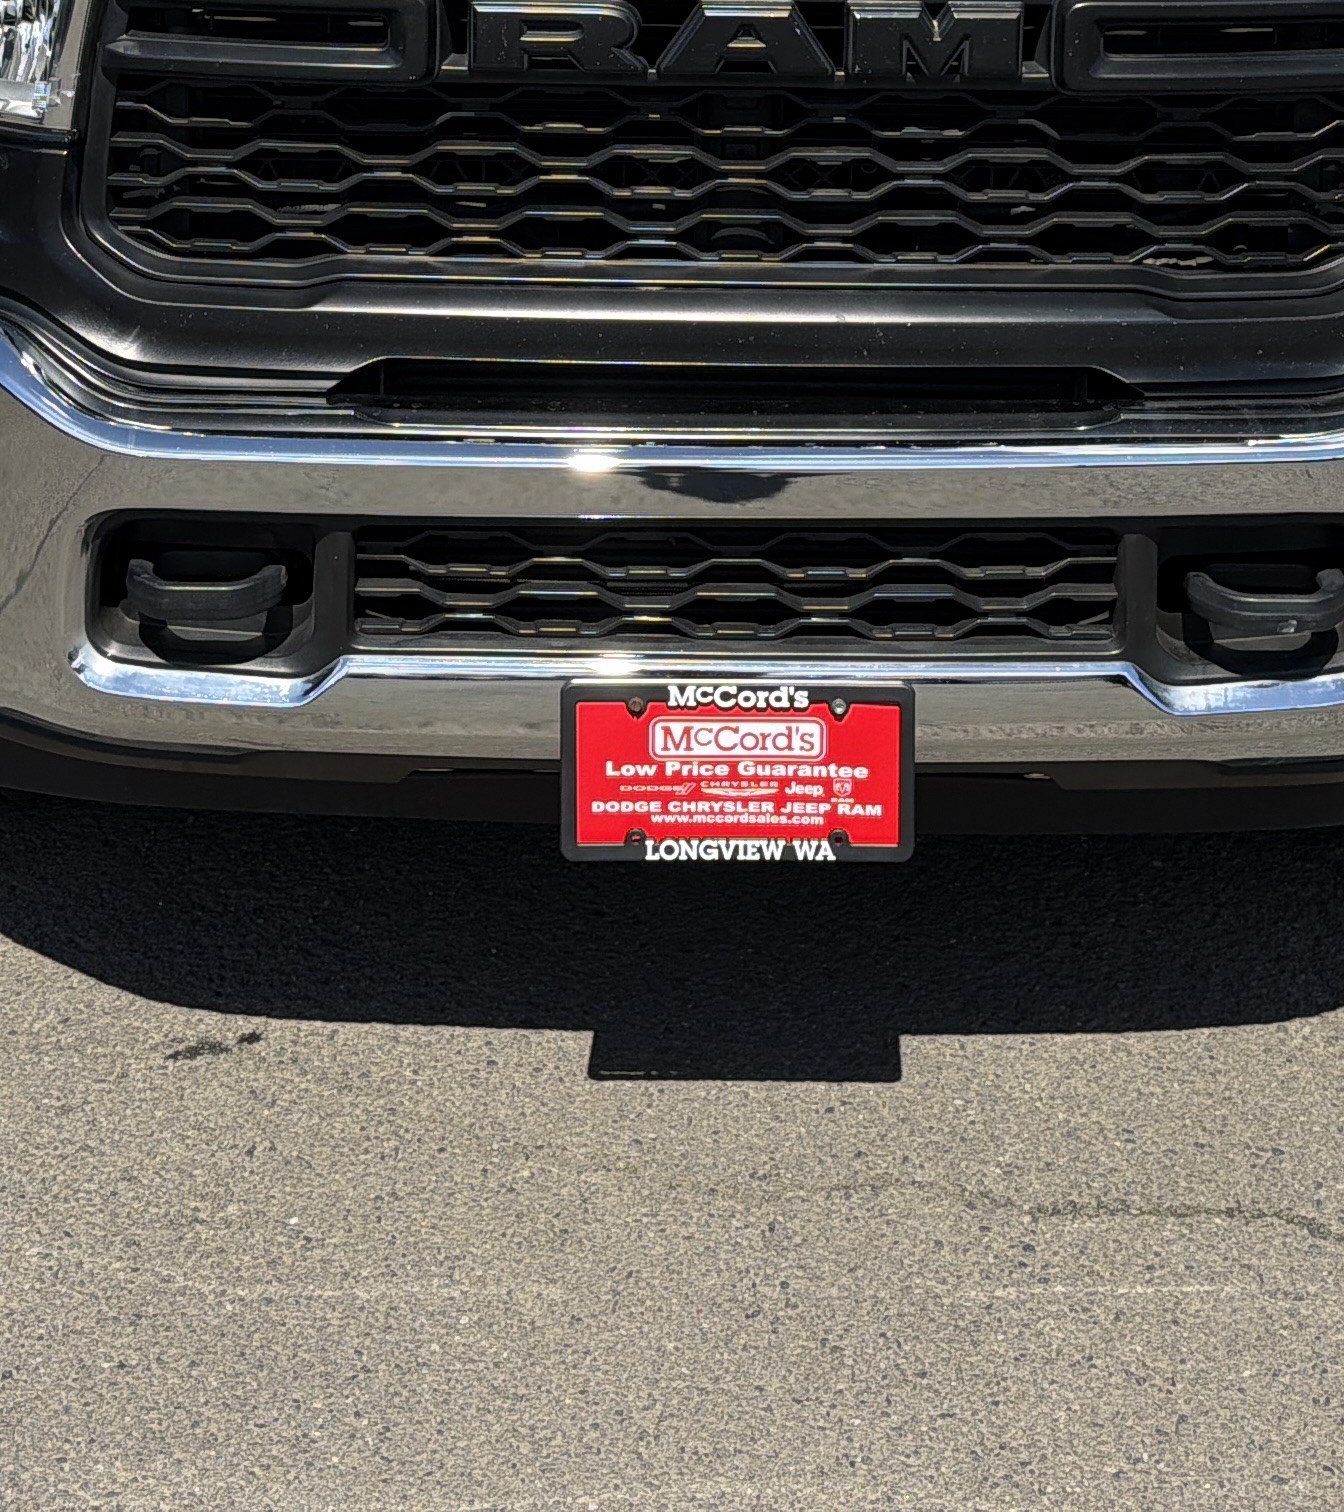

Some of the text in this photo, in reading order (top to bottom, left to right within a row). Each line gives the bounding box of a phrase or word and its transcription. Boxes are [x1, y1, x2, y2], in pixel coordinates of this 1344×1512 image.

[667, 685, 810, 709] McCord's
[660, 725, 815, 752] McCord's
[605, 760, 869, 779] Low Price Guarantee
[784, 781, 824, 797] Jeep
[591, 800, 883, 816] DODGE CHRYSLER JEEP RAM
[650, 813, 824, 825] www.mccordsales.com
[644, 839, 836, 861] LONGVIEW WA
